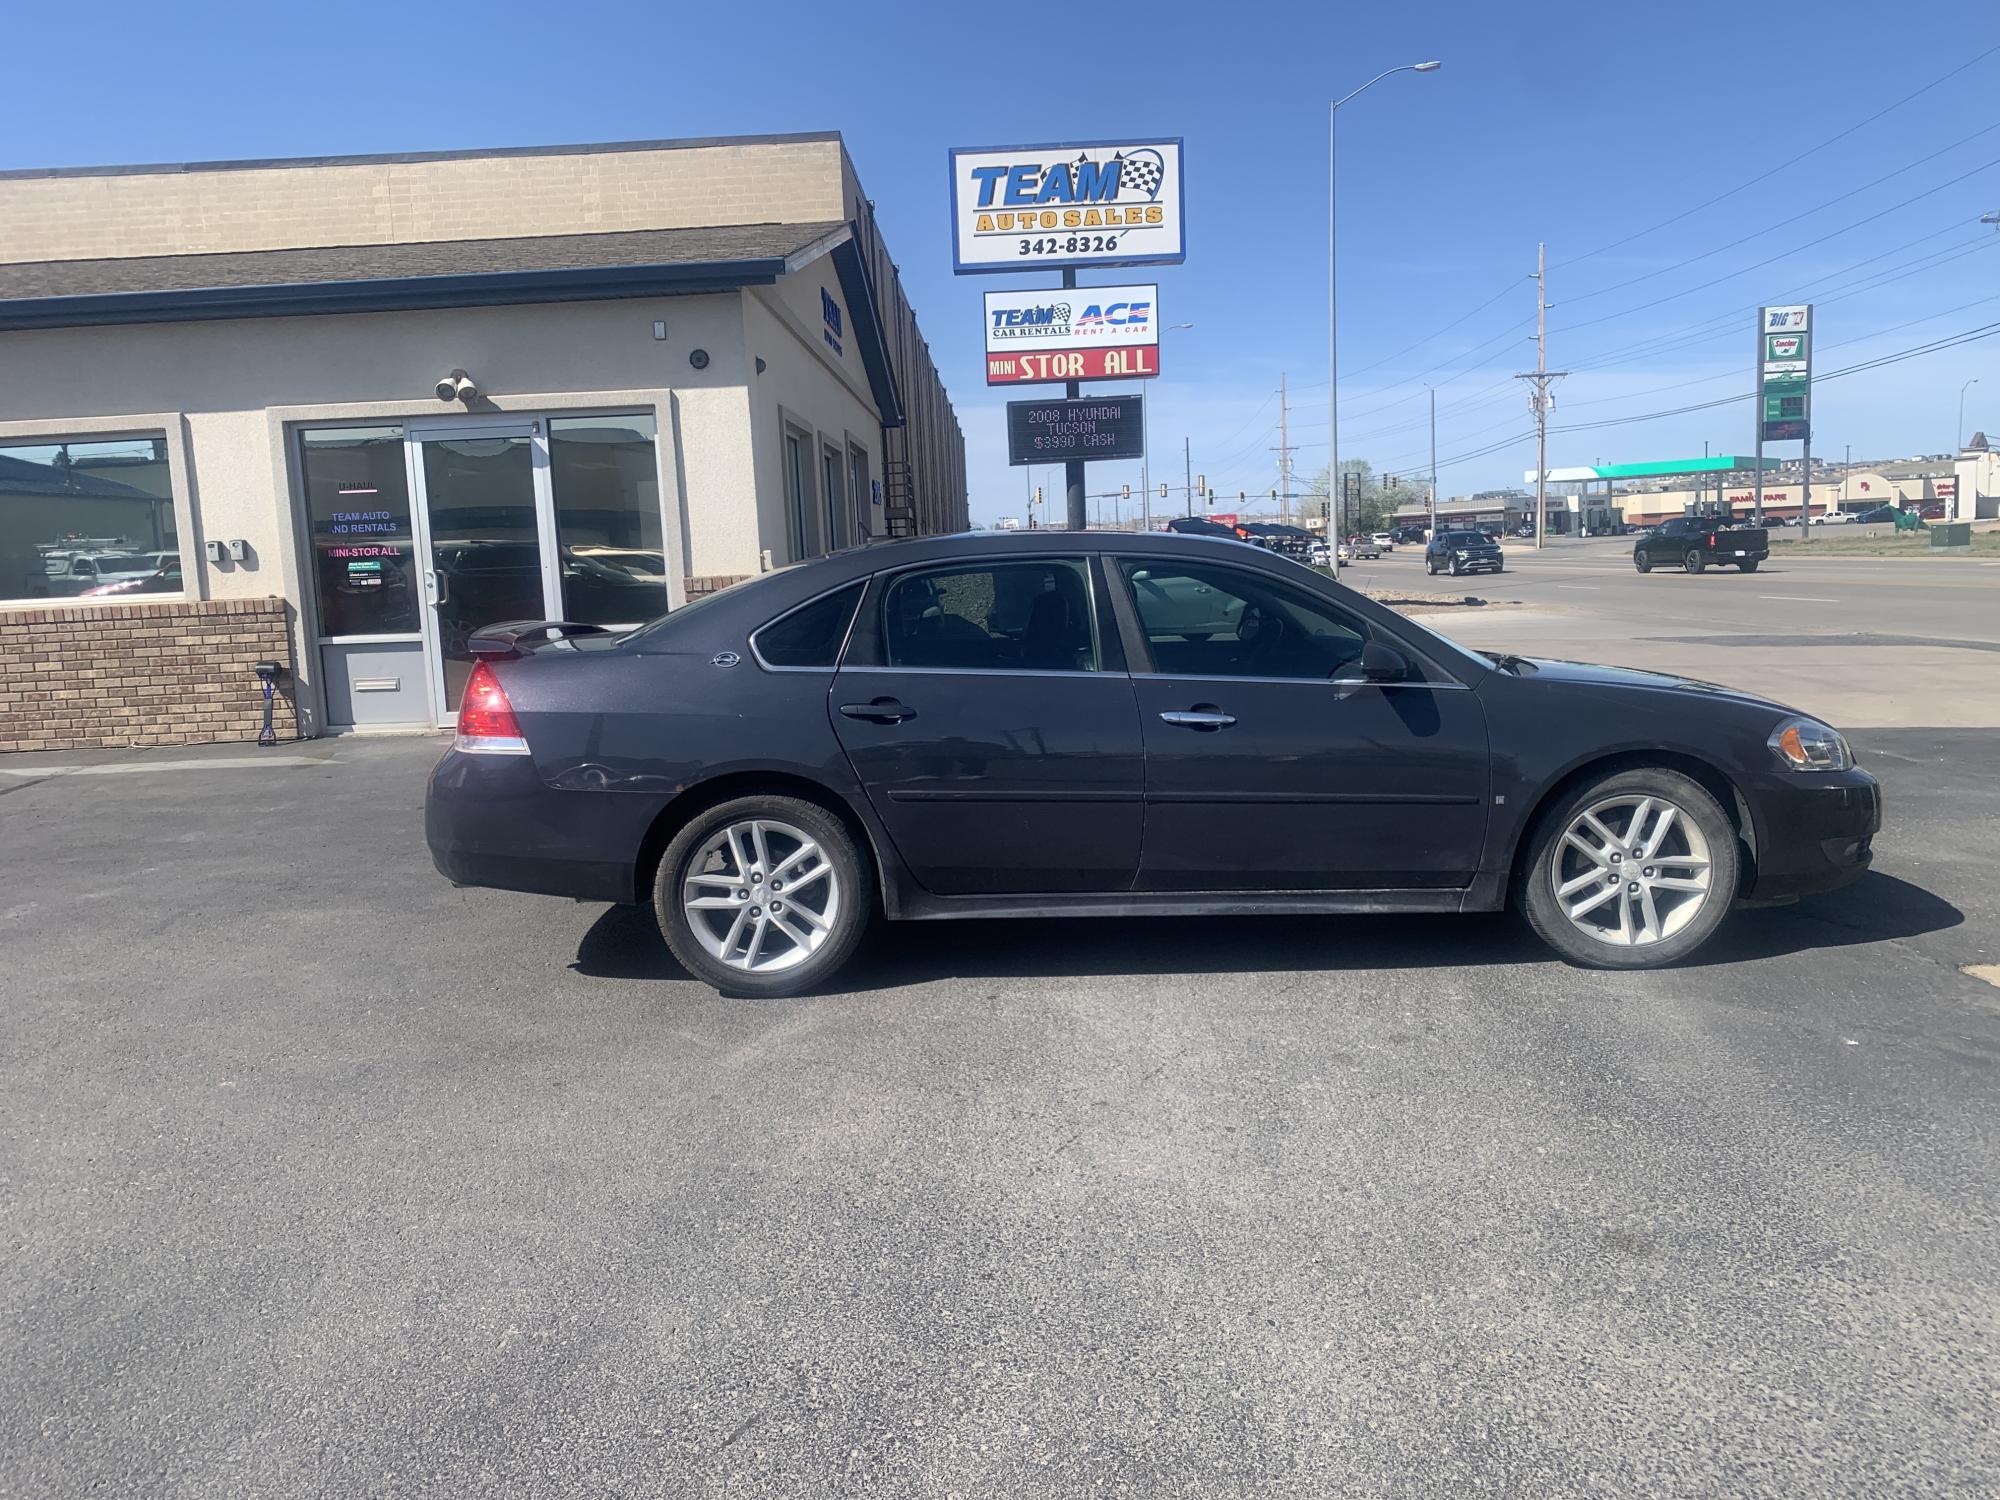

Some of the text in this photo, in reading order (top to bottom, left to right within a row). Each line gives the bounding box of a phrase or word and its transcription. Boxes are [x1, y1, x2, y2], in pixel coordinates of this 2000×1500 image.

[971, 160, 1124, 207] TEAM
[976, 206, 1163, 231] AUTO SALES
[1019, 235, 1118, 255] 342-8326
[992, 306, 1055, 327] TEAM
[1075, 302, 1151, 326] ACE
[1769, 312, 1790, 327] BIG
[993, 326, 1071, 337] CAR RENTALS
[1074, 328, 1104, 336] RENT
[989, 349, 1153, 379] MINI STOR ALL
[1028, 406, 1121, 423] 2008 HYUNDAI
[1046, 420, 1096, 435] TUCSON
[1034, 433, 1115, 449] $3990 CASH
[1764, 494, 1787, 502] FARE
[332, 511, 390, 521] TEAM AUTO
[351, 523, 397, 532] RENTALS
[328, 547, 400, 557] MINI-STOR ALL
